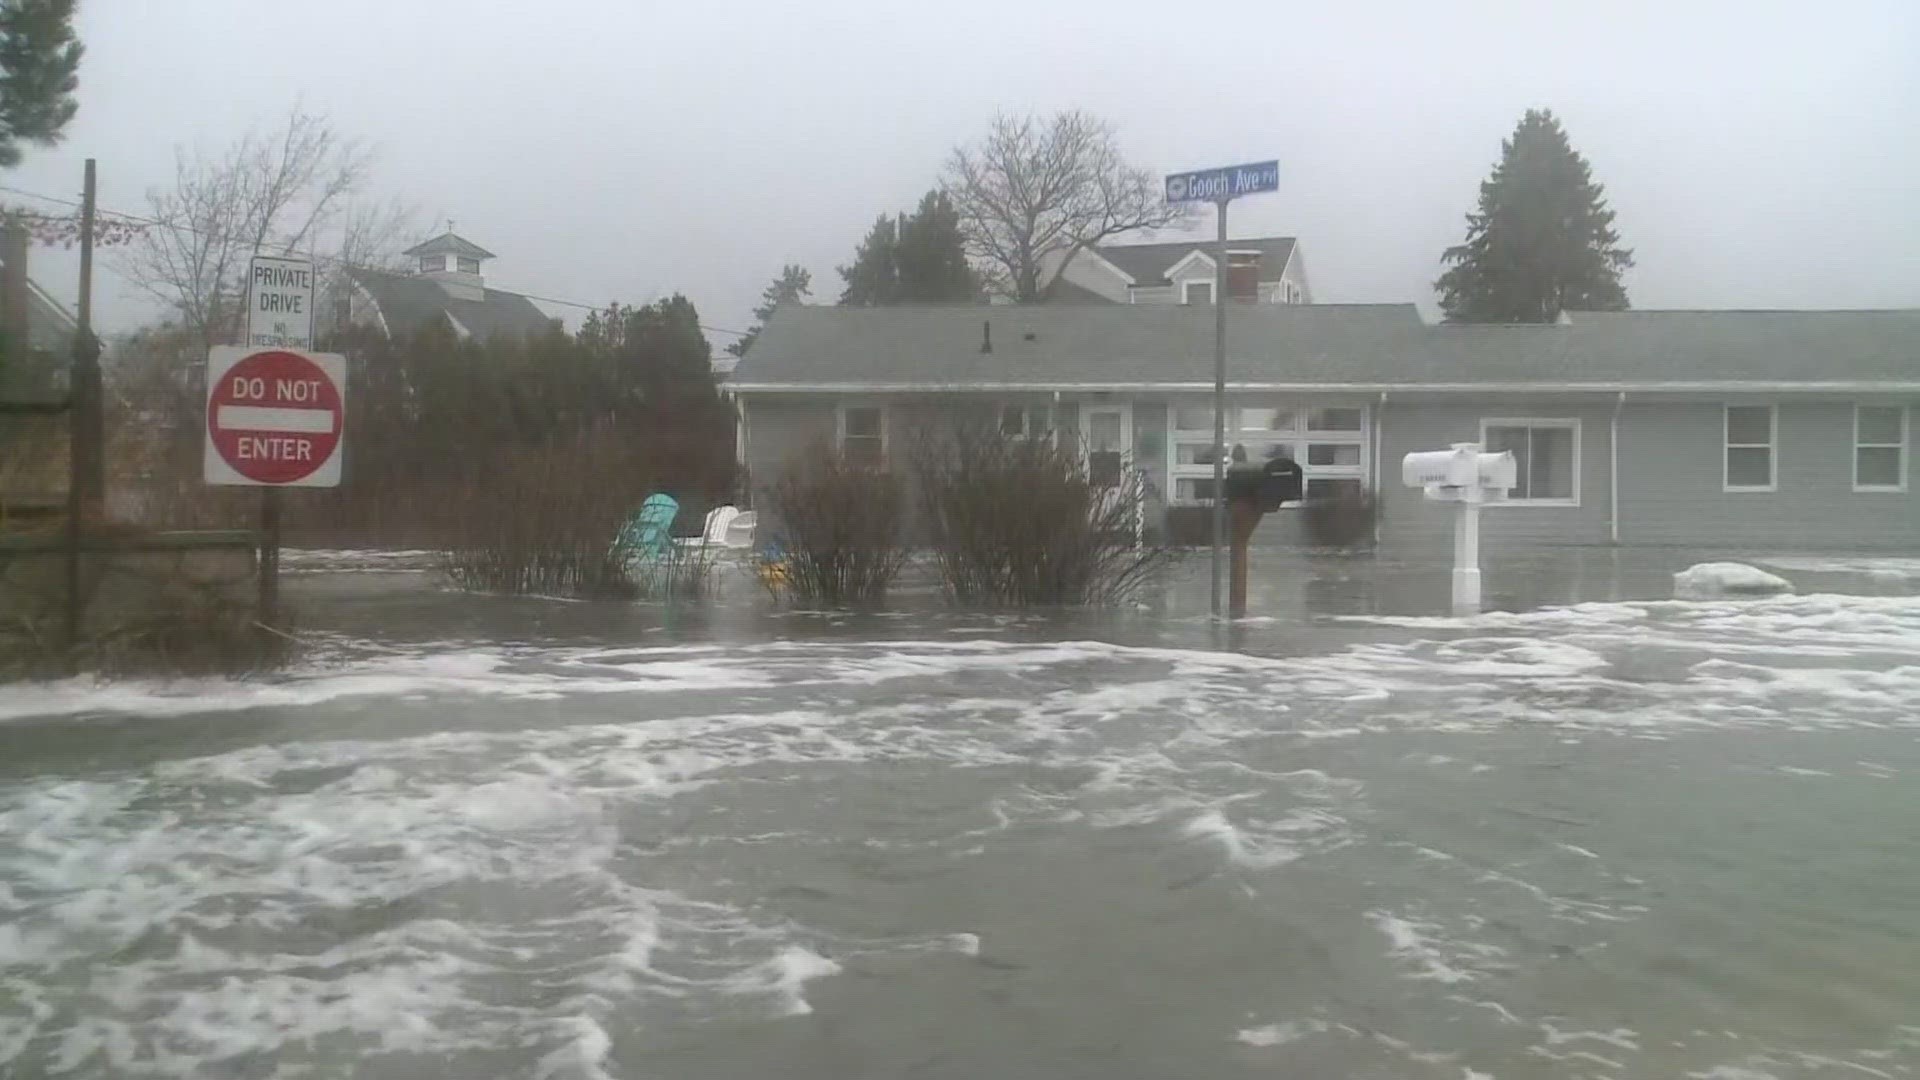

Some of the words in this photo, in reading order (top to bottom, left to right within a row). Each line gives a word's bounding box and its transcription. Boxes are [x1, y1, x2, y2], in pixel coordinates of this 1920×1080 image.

[1188, 173, 1229, 198] Gooch
[1235, 169, 1259, 193] Ave
[254, 266, 310, 288] PRIVATE
[260, 292, 303, 313] DRIVE
[273, 322, 286, 335] NO
[232, 376, 264, 400] DO
[276, 379, 320, 402] NOT
[237, 437, 312, 461] ENTER
